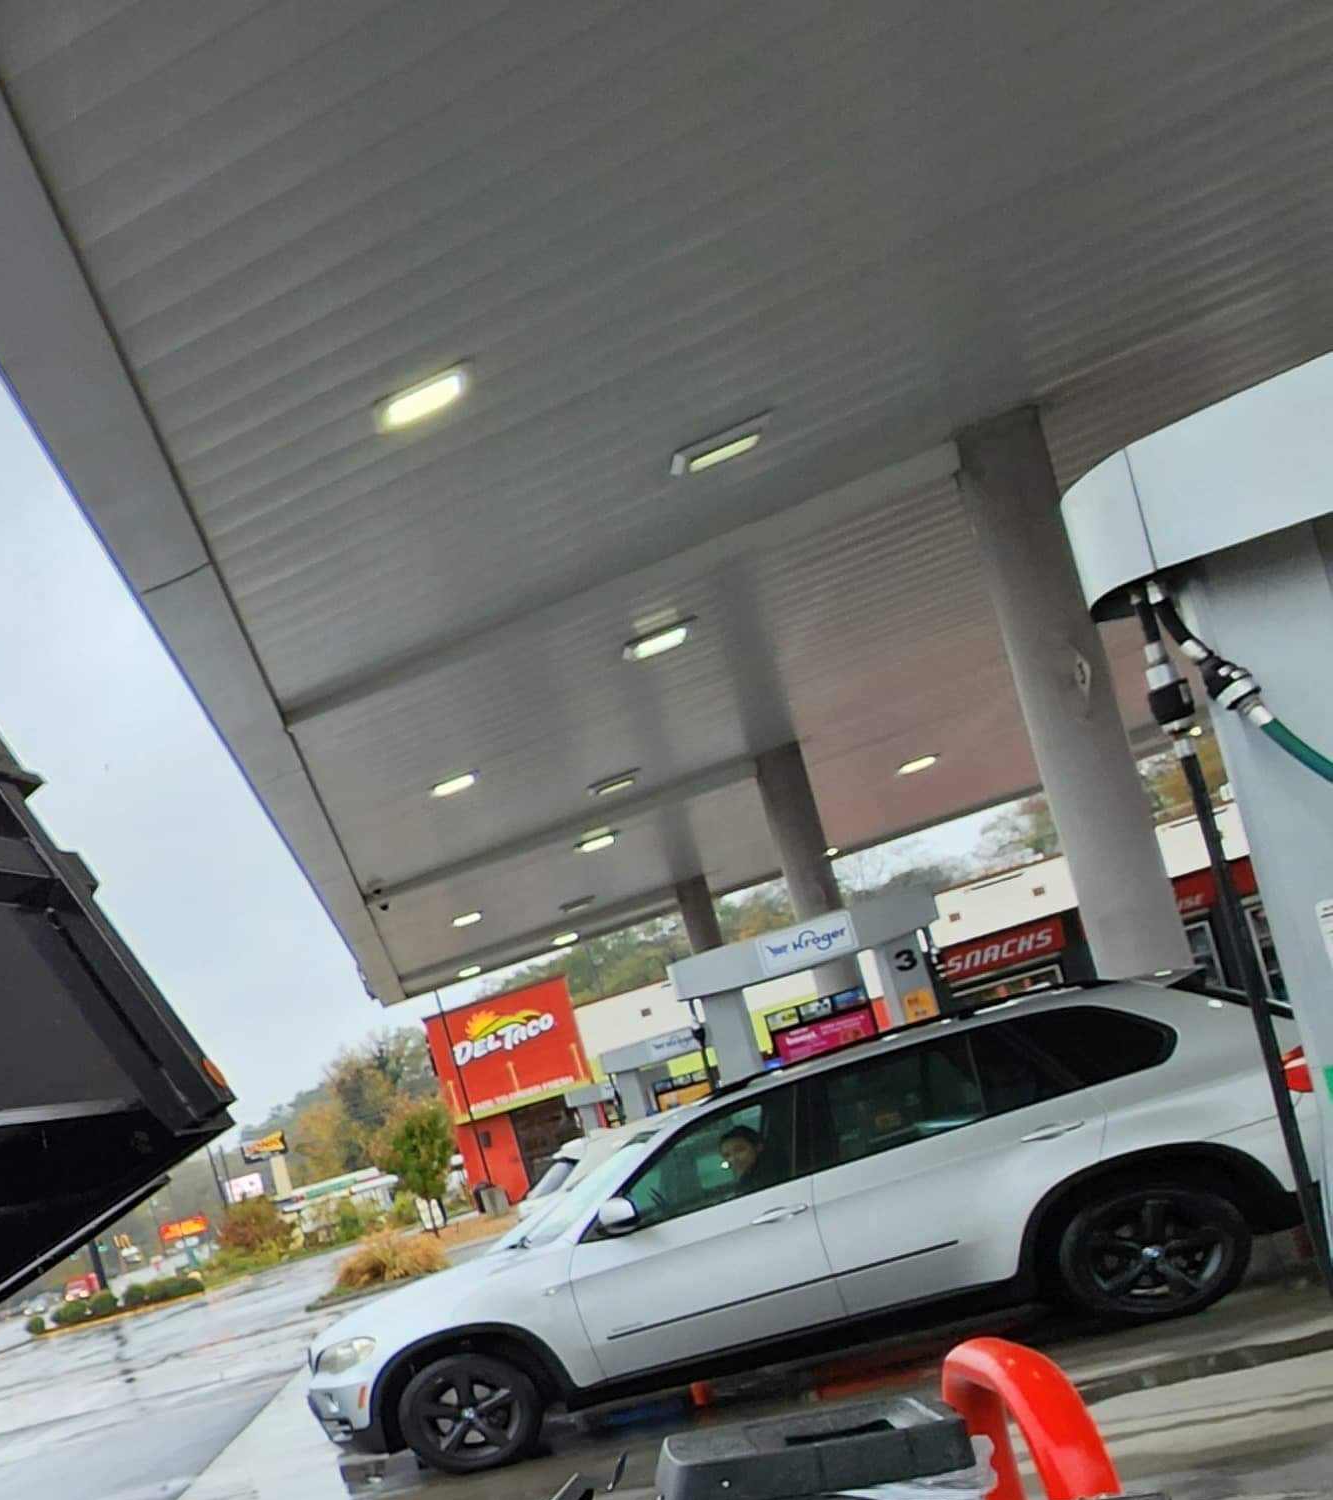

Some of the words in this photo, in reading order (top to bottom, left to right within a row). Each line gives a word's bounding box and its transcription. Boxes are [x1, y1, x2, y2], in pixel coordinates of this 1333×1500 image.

[792, 927, 846, 951] Kroger
[945, 928, 1053, 975] SNACKS
[894, 949, 918, 971] 3
[452, 1034, 502, 1066] DEL
[498, 1013, 555, 1050] TACO
